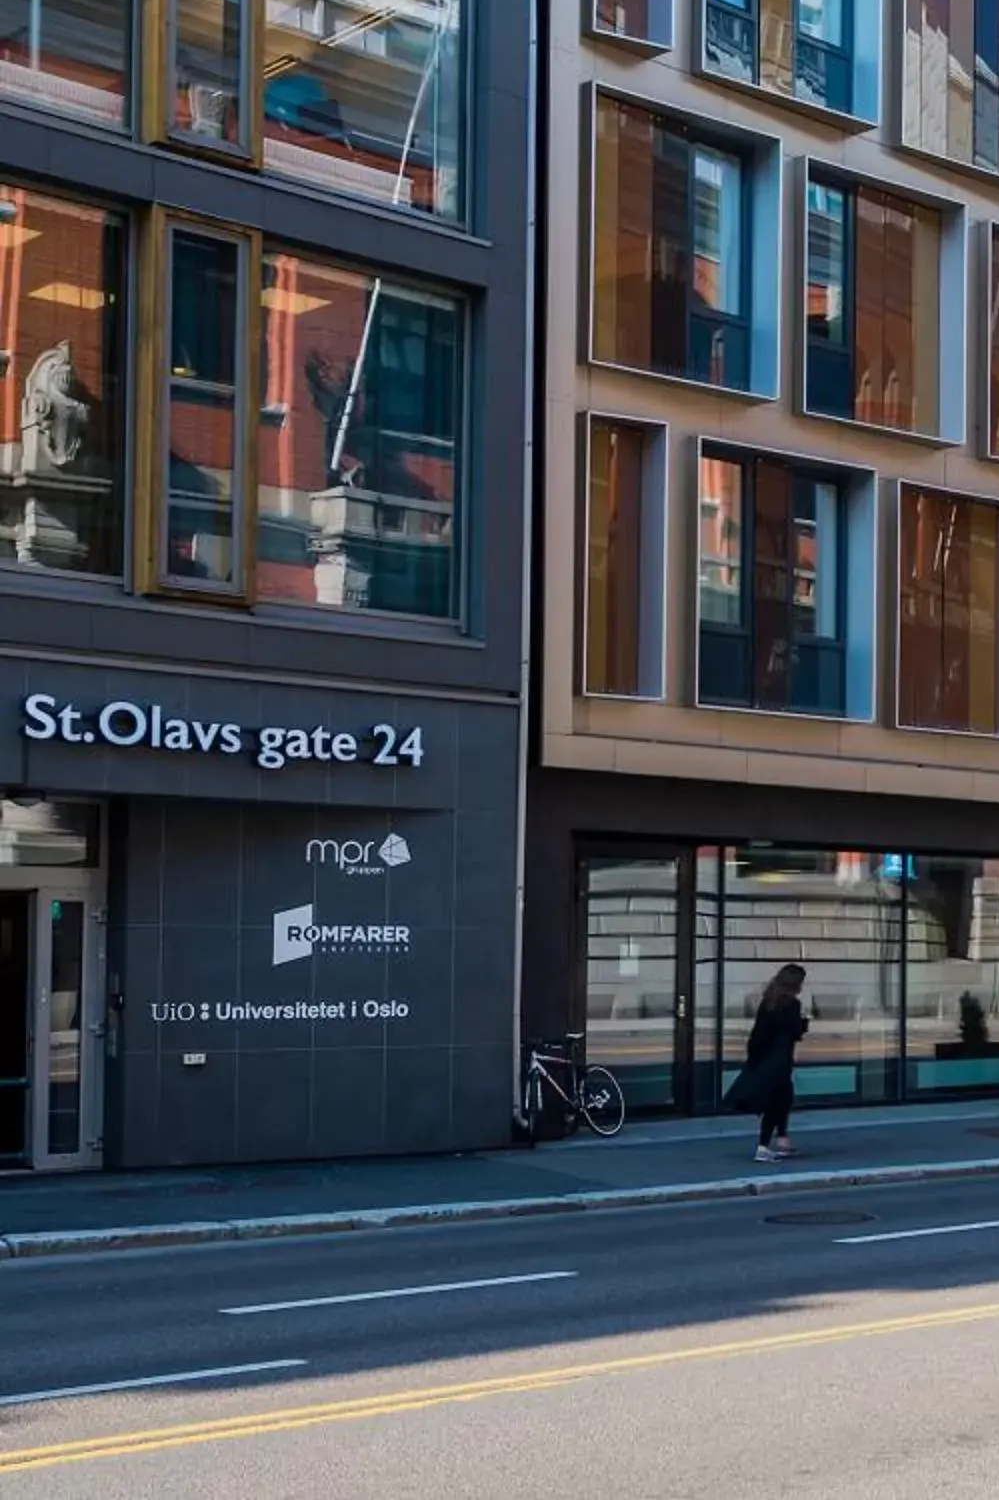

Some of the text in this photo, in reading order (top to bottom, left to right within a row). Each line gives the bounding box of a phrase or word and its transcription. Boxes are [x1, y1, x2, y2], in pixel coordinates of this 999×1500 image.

[257, 724, 358, 770] gate
[372, 723, 424, 767] 24
[305, 839, 375, 870] mpr
[287, 925, 411, 943] ROMFARER
[215, 1001, 346, 1021] Universitetet
[350, 1001, 357, 1018] i
[363, 999, 410, 1018] Oslo
